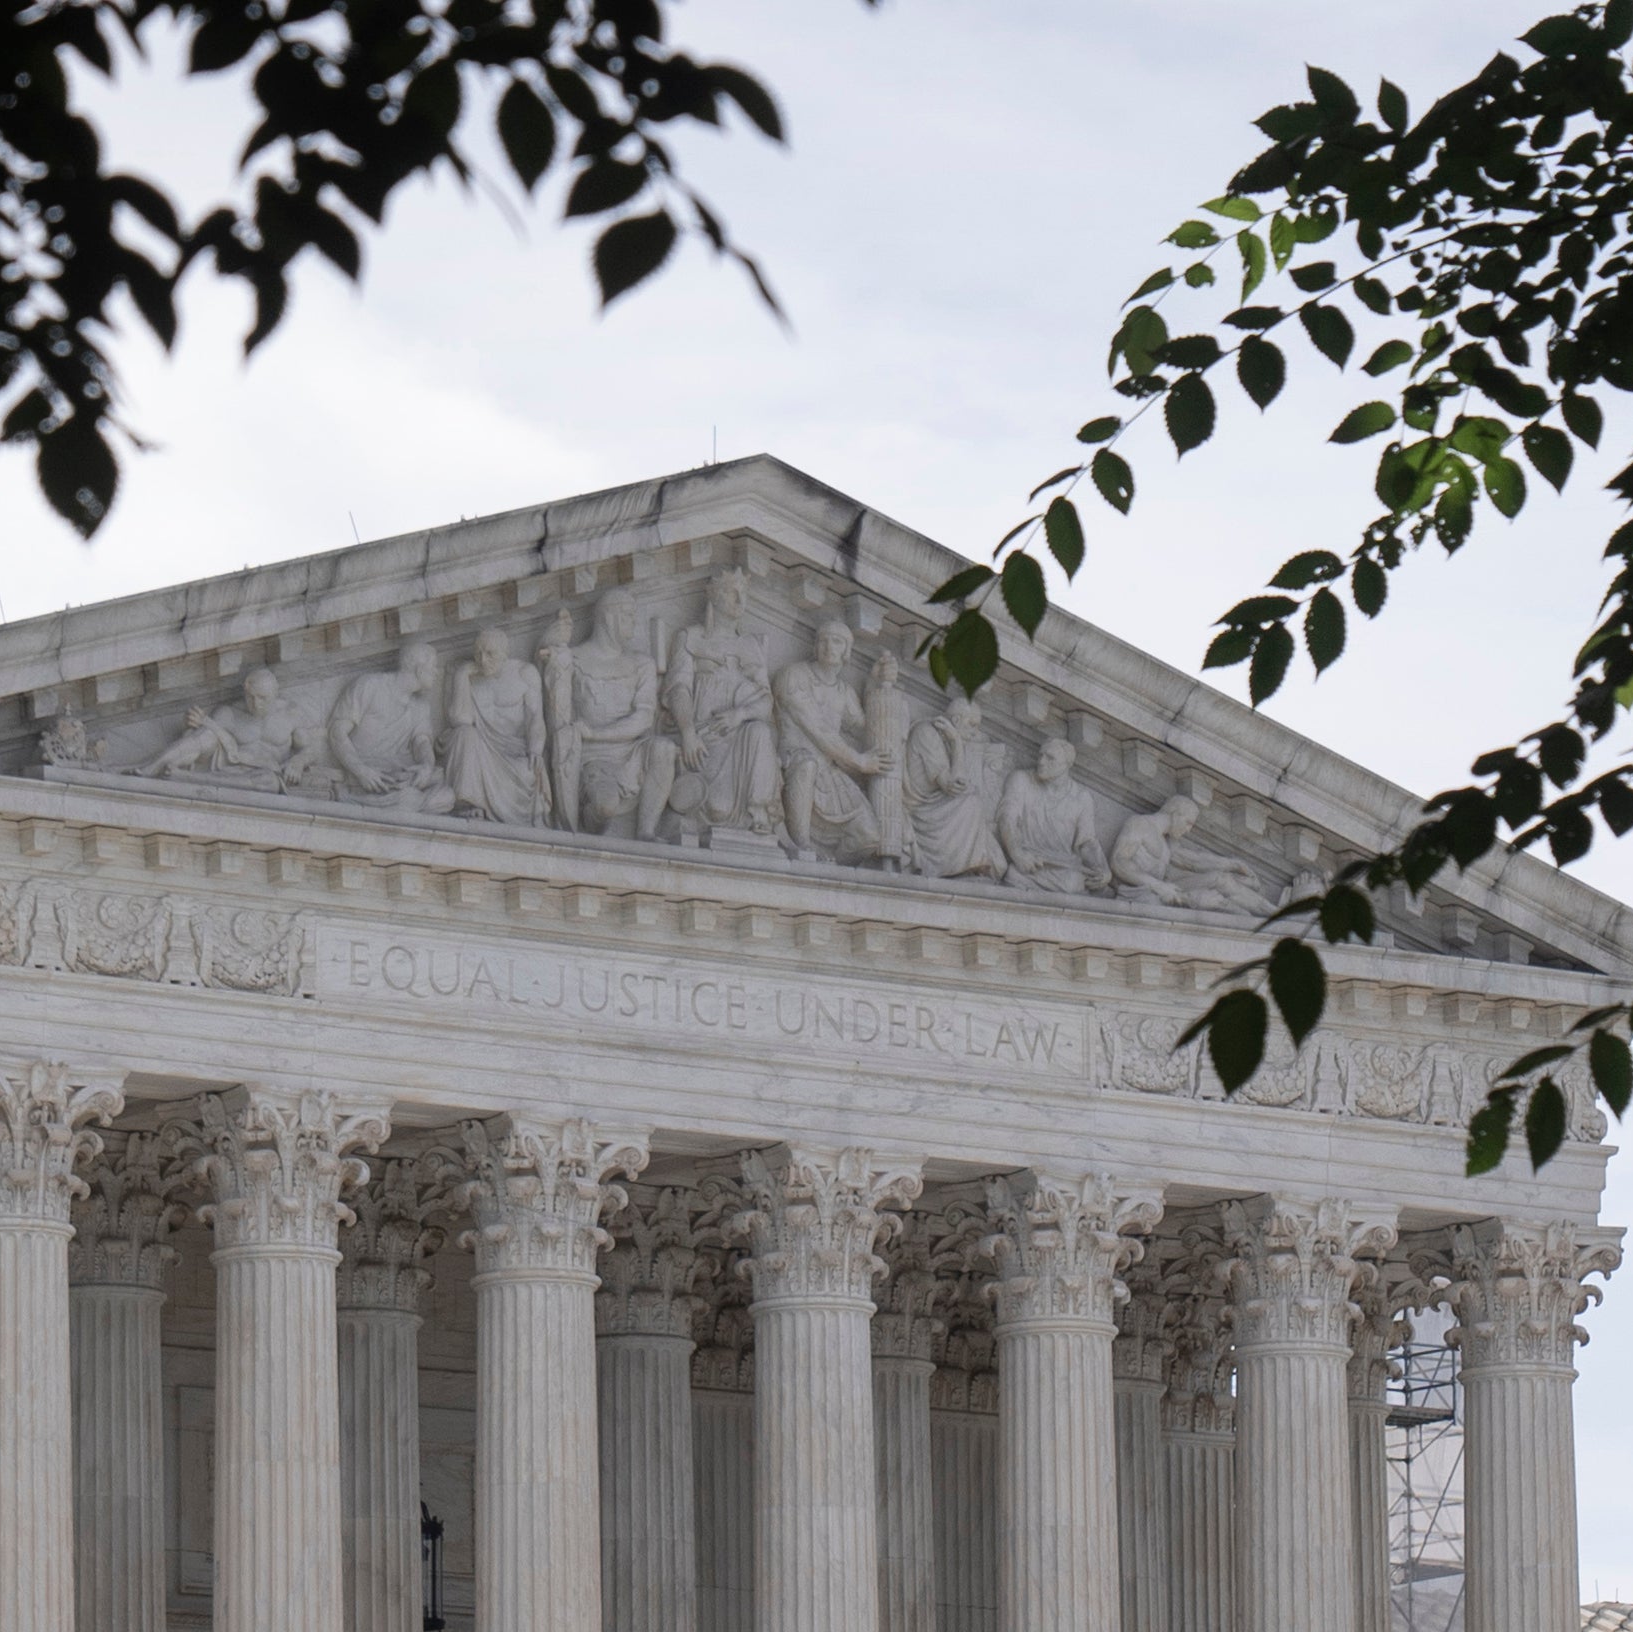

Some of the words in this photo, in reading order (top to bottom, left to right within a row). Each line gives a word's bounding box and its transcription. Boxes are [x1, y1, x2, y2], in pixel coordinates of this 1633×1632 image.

[349, 940, 530, 1005] EQUAL
[542, 964, 748, 1031] JUSTICE
[775, 989, 950, 1052] UNDER
[965, 1012, 1060, 1064] LAW
